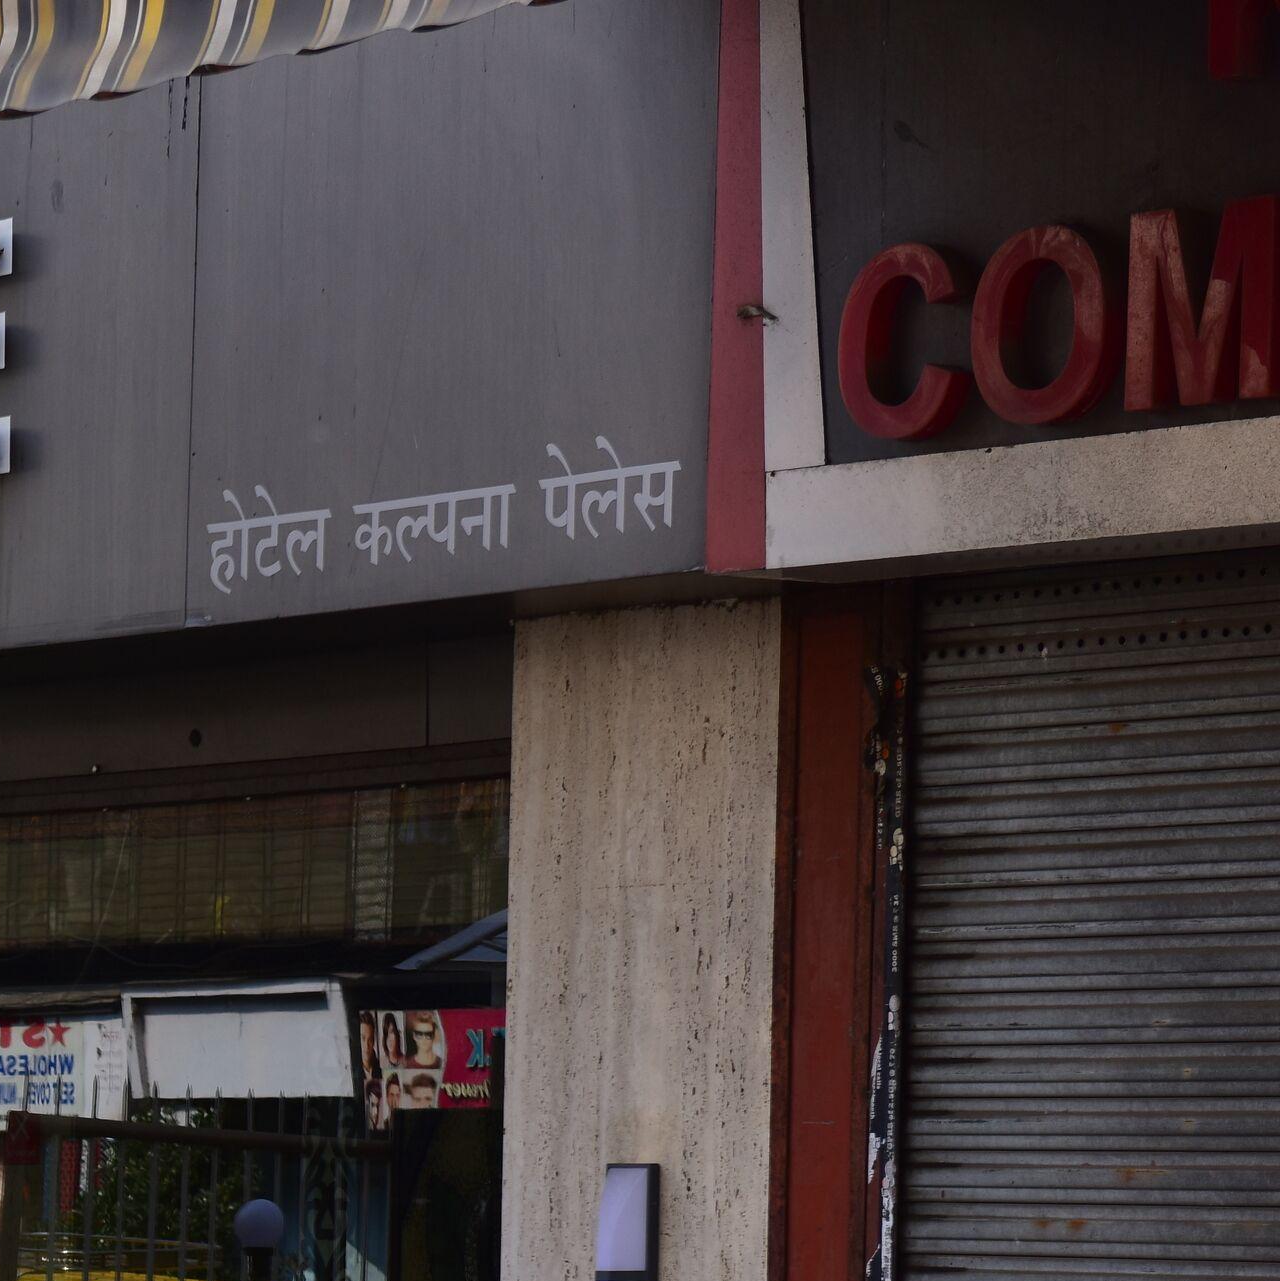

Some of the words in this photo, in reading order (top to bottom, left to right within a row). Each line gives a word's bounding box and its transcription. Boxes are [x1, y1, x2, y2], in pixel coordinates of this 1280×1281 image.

[208, 485, 331, 594] होटेल
[353, 482, 517, 567] कल्पना
[539, 436, 682, 541] पेलेस
[886, 1122, 894, 1149] GPRS
